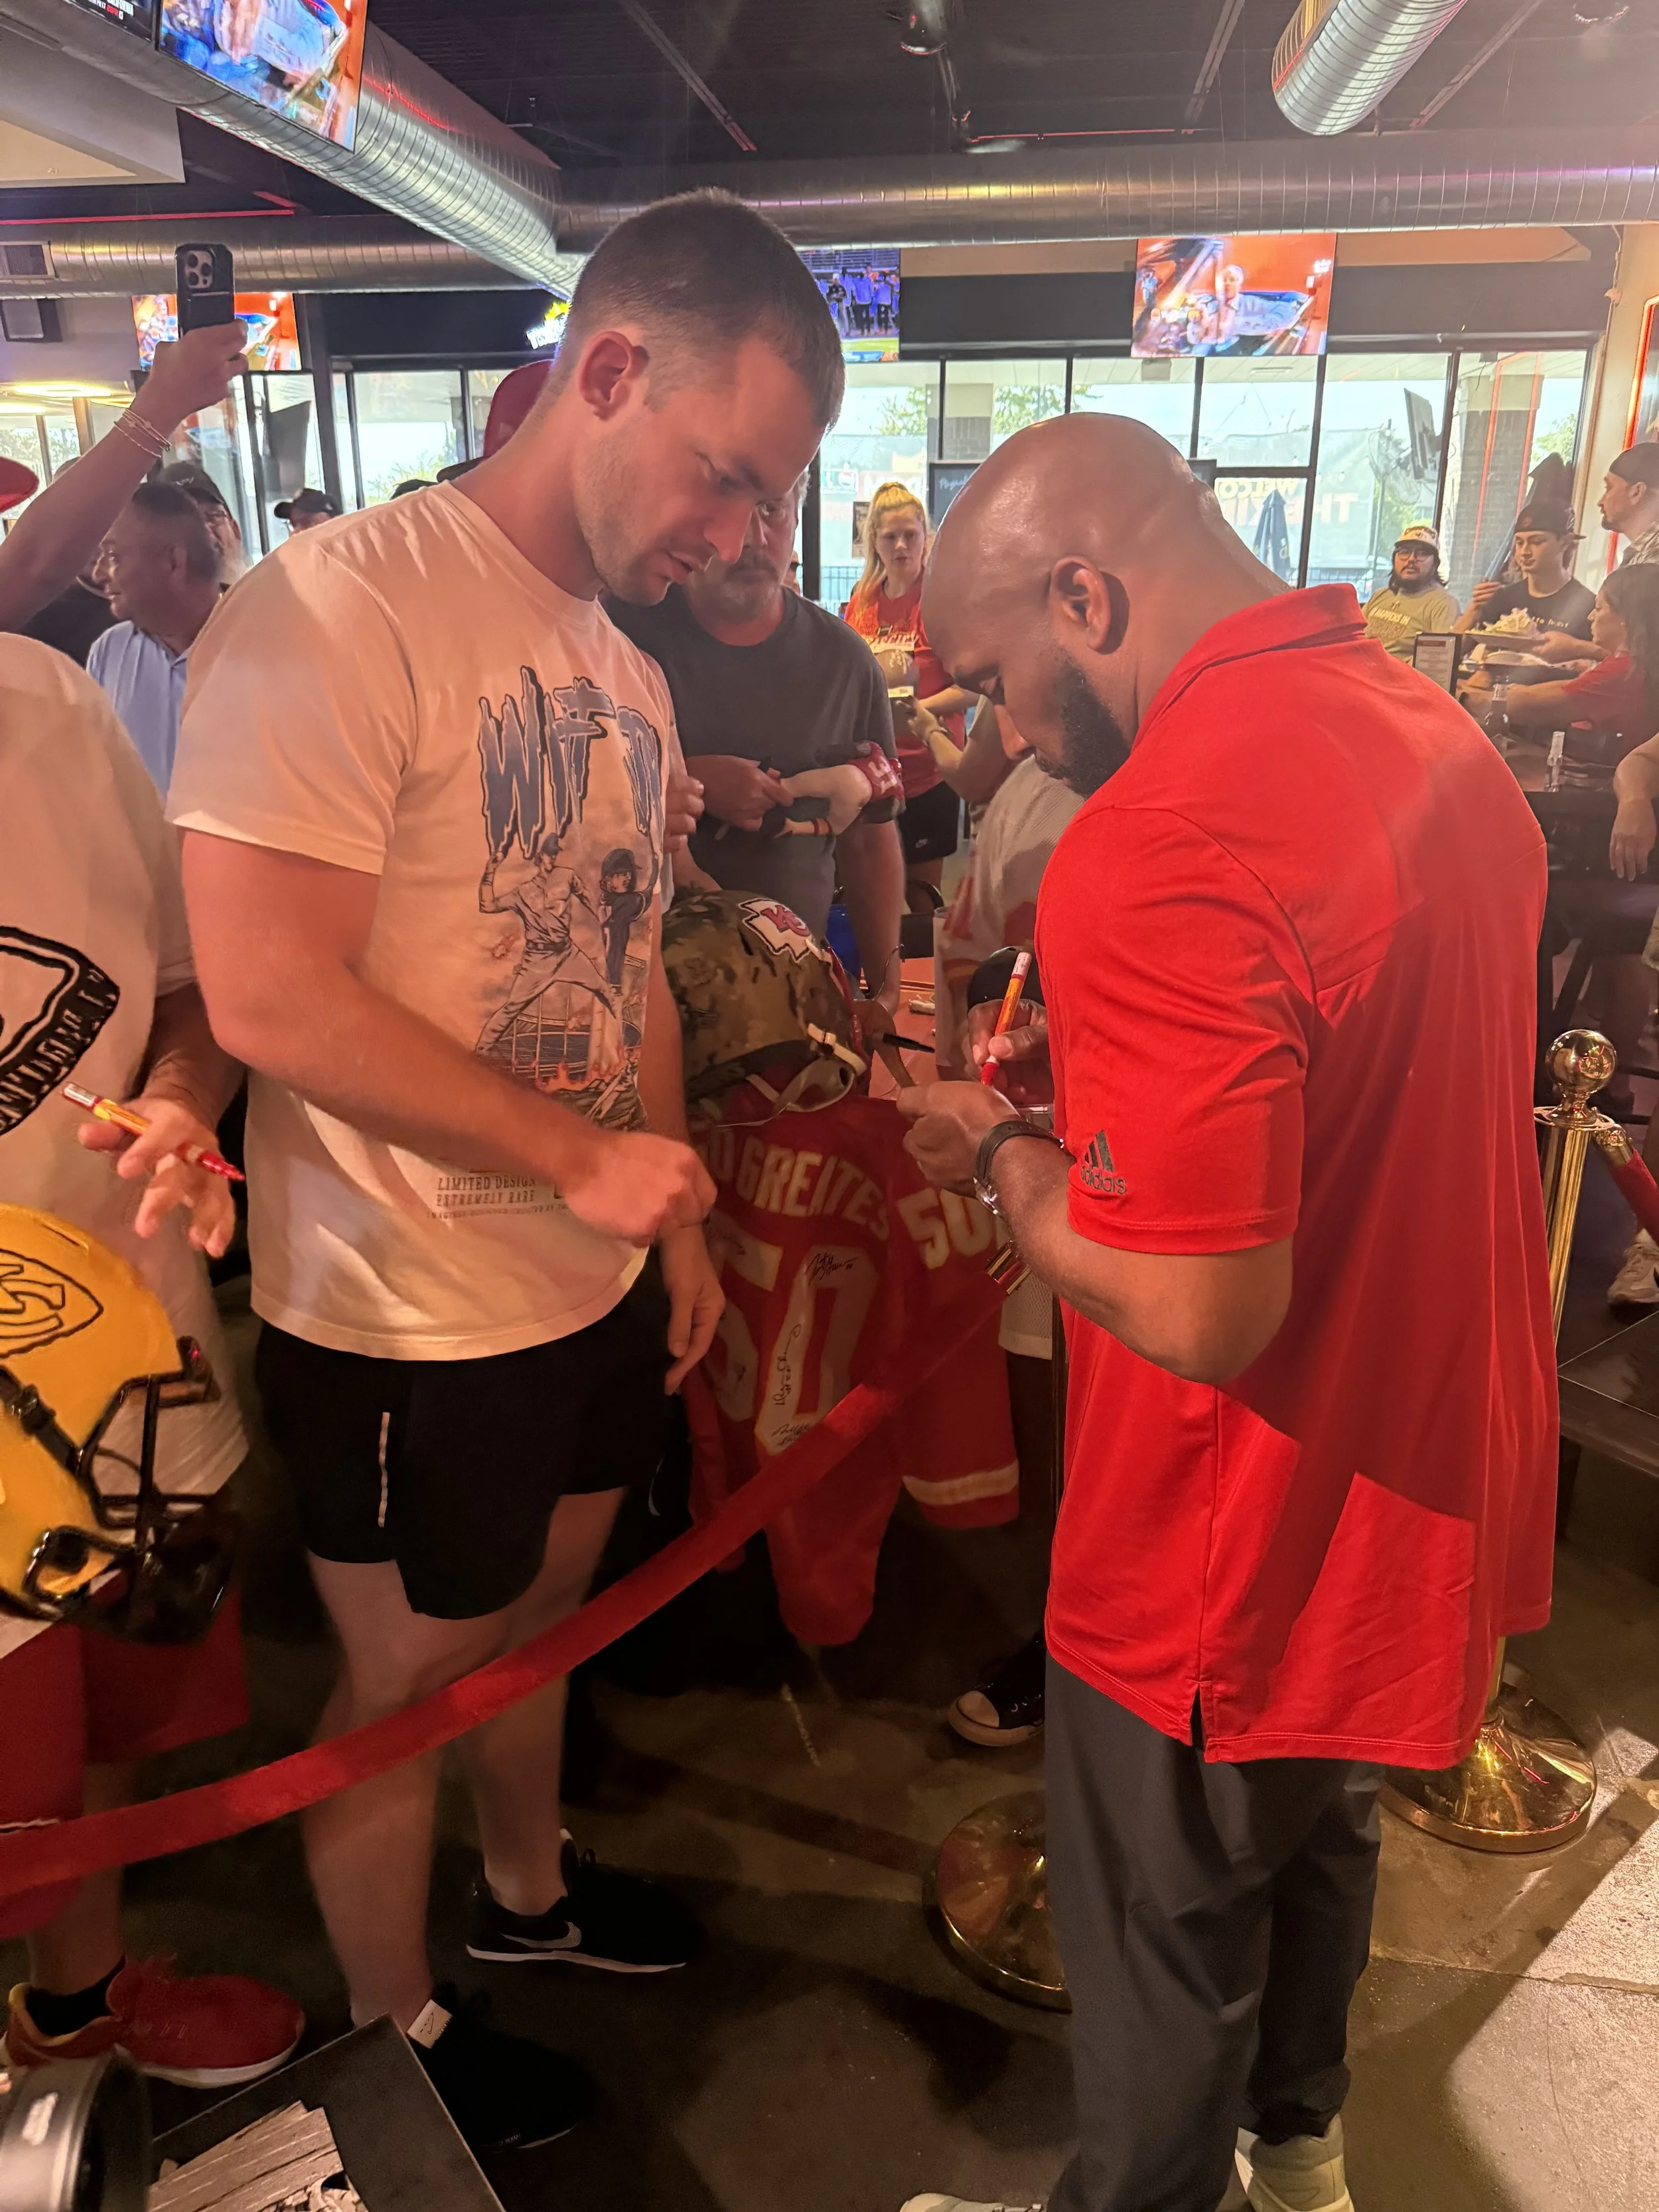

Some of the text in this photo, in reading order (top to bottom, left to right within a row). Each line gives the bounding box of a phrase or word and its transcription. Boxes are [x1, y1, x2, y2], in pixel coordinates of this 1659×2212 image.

[760, 905, 810, 937] KC
[437, 1175, 536, 1191] LIMITED DESIGN
[897, 1187, 993, 1270] 50
